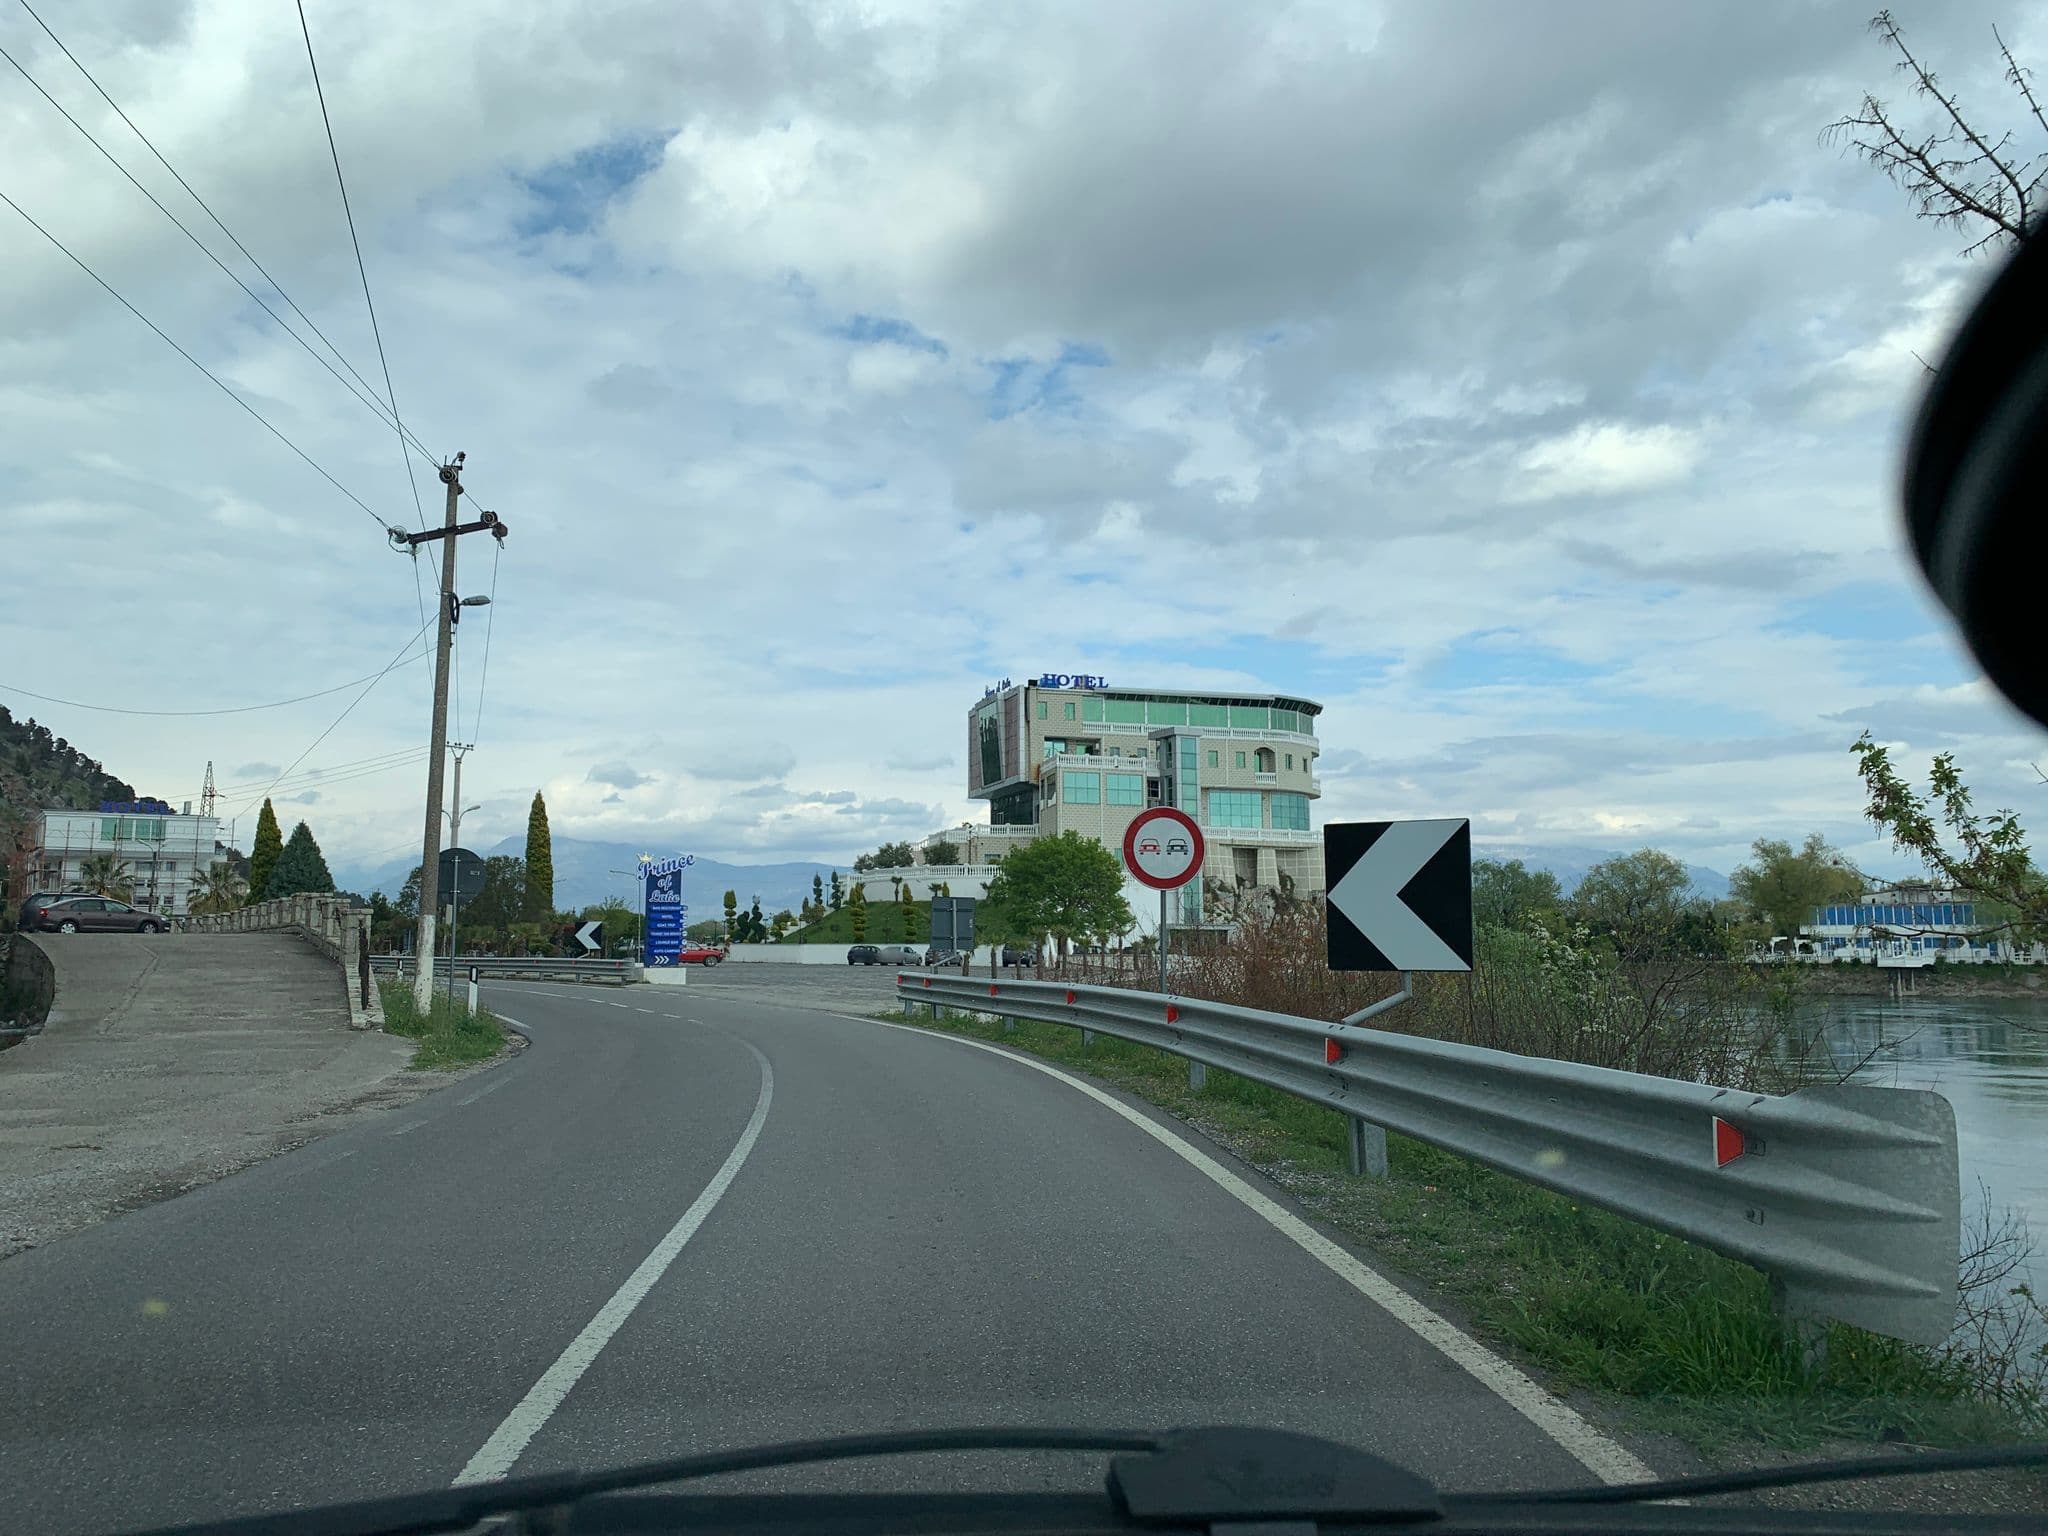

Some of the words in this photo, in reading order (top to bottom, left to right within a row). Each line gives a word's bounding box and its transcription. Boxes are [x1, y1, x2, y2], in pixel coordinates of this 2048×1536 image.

[1041, 673, 1109, 689] HOTEL
[638, 855, 695, 880] Prince
[657, 875, 672, 891] of
[649, 890, 680, 902] Lake
